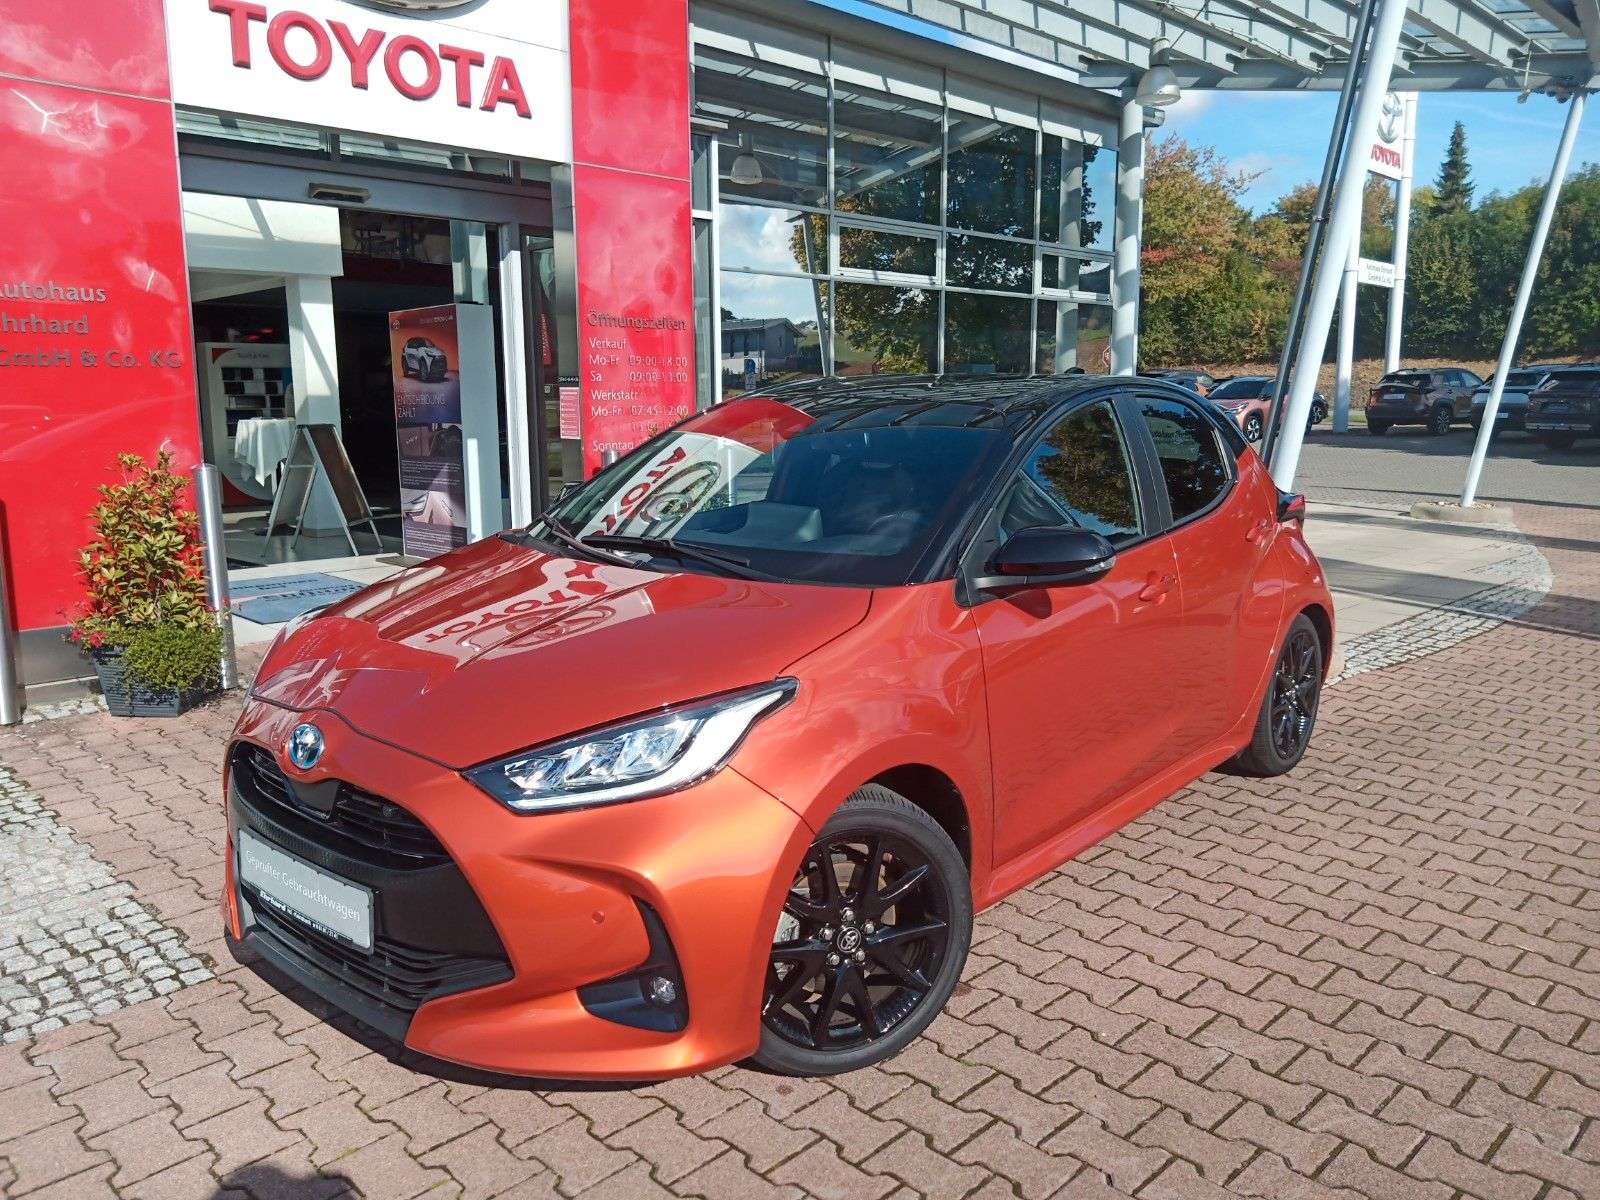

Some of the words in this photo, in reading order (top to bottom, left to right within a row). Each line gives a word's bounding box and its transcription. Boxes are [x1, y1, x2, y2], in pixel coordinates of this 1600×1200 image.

[209, 0, 532, 119] TOYOTA
[1370, 143, 1401, 169] TOYOTA
[1, 312, 90, 334] hrhard
[589, 337, 627, 350] Verkauf
[81, 348, 98, 367] &
[105, 350, 143, 368] Co.
[150, 351, 183, 369] KG
[590, 371, 602, 382] Sa
[591, 390, 639, 401] Werkstatt
[593, 440, 634, 453] Sonntag
[246, 851, 281, 881] Geprüfter
[282, 872, 360, 922] Gebrauchtwagen
